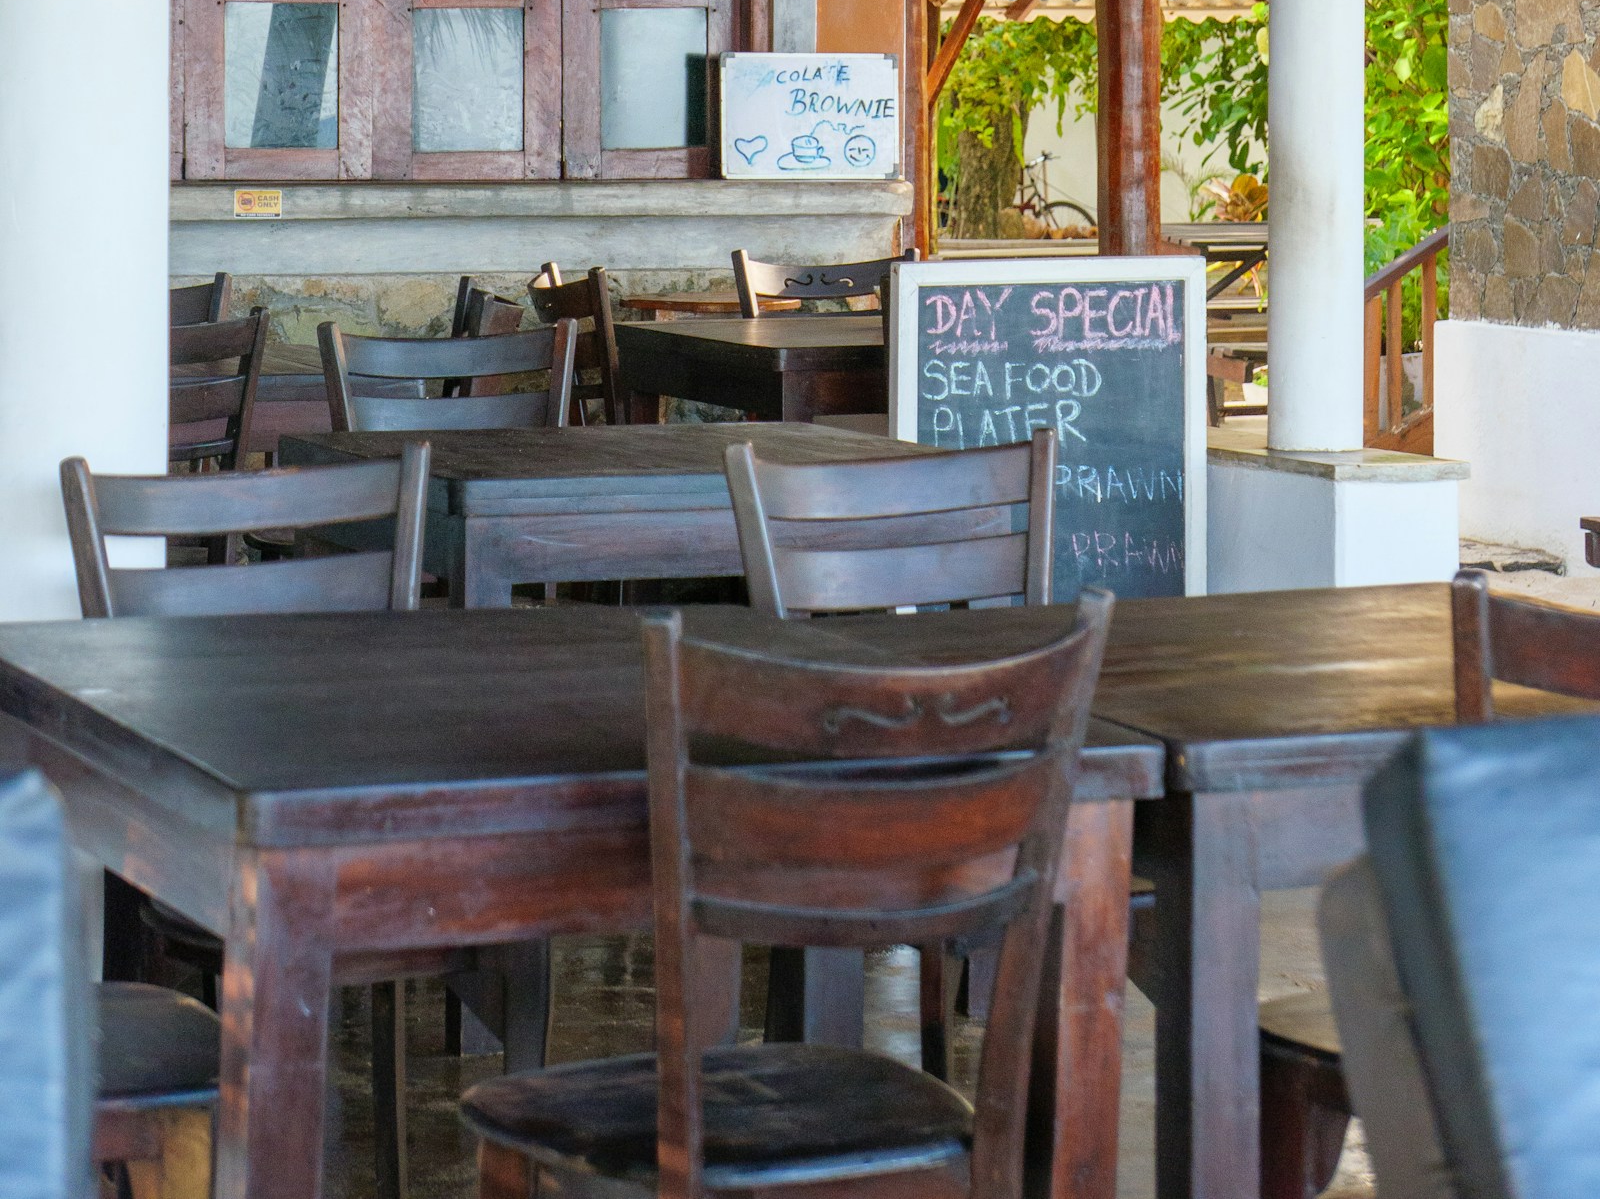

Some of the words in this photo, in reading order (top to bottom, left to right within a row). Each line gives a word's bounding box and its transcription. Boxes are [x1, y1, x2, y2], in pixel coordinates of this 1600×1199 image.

[786, 88, 895, 119] BROWNIE
[926, 287, 1012, 341] DAY
[1030, 283, 1182, 342] SPECIAL
[1055, 464, 1183, 504] PRAWN
